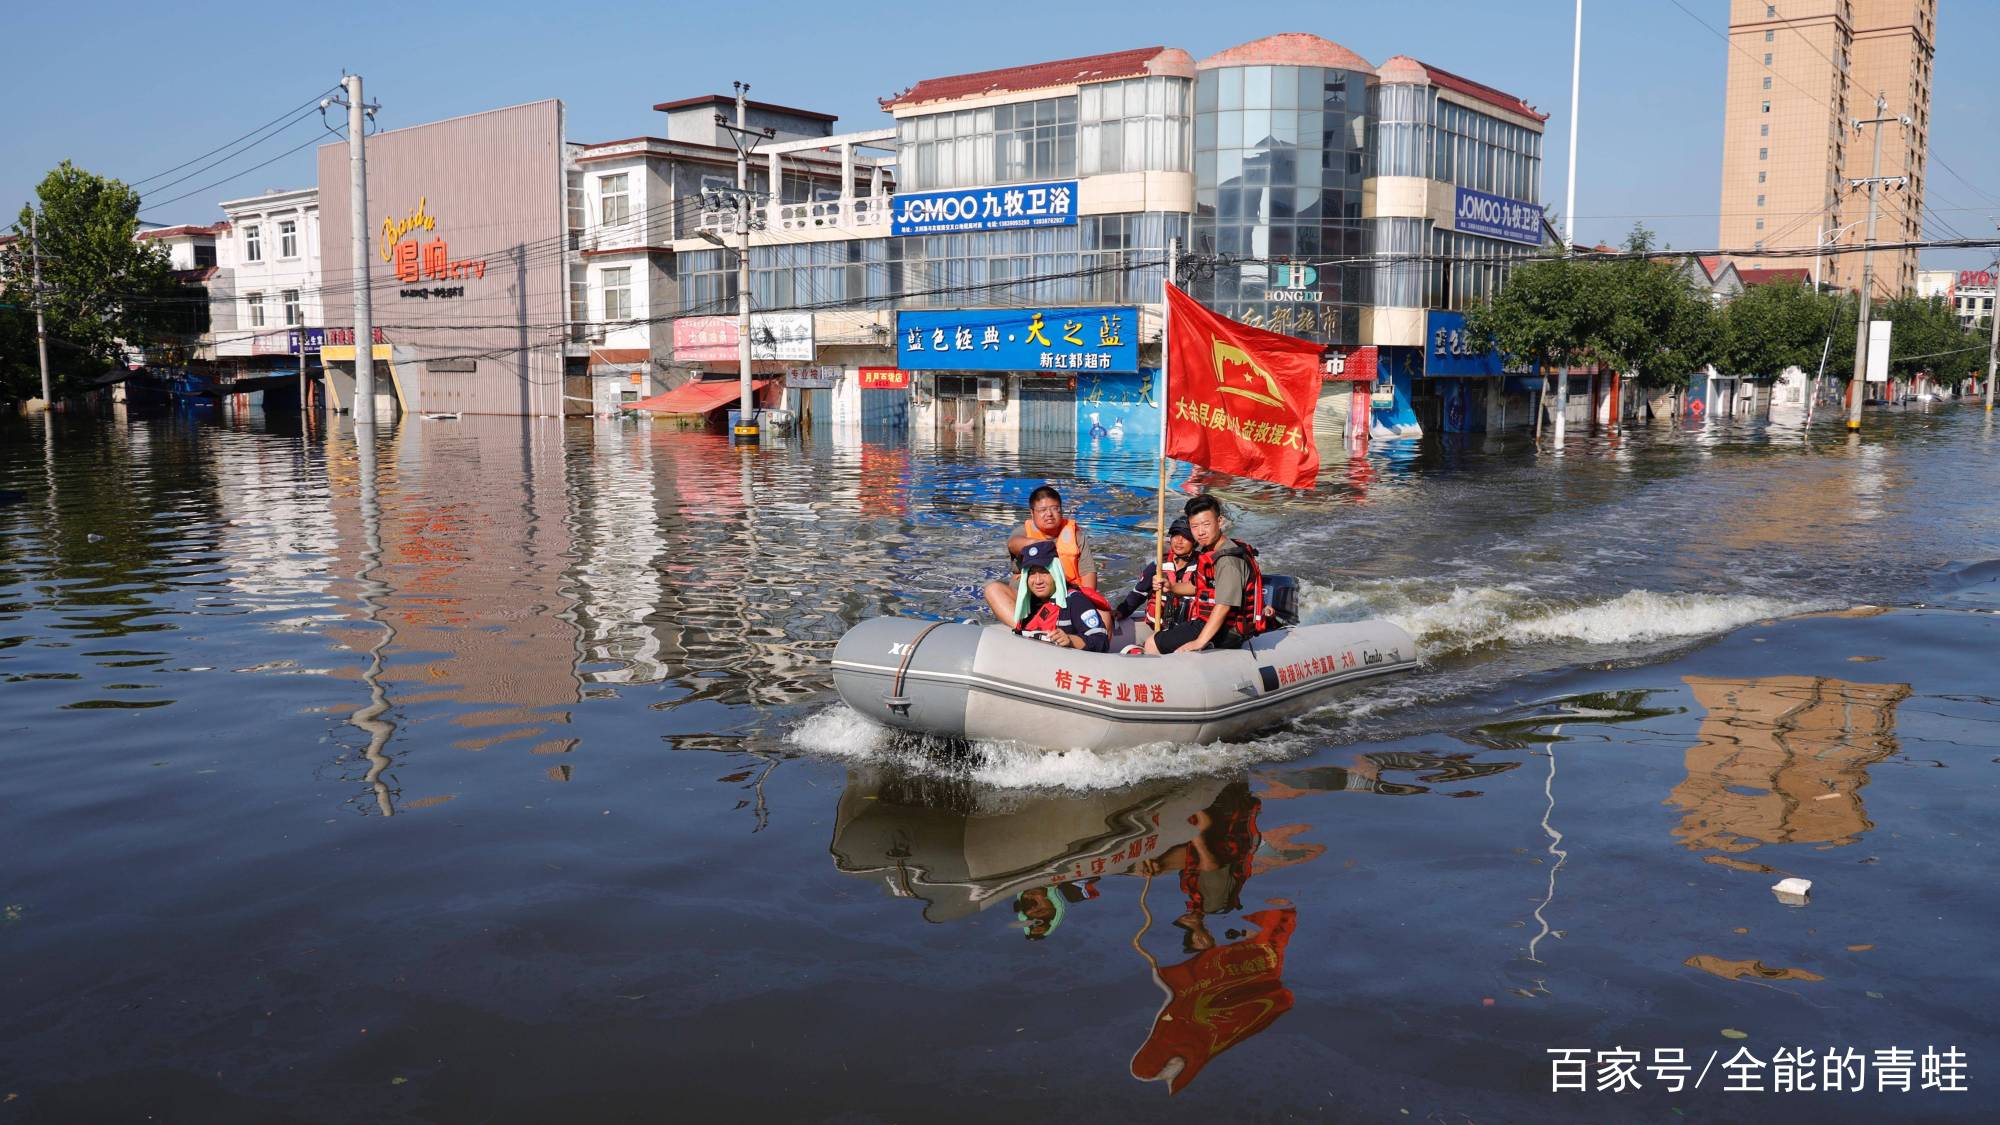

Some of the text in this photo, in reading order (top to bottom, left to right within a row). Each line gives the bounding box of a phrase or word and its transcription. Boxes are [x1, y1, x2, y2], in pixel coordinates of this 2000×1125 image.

[897, 187, 1071, 224] JOMOO 九牧卫浴
[1458, 194, 1501, 225] JOMOO
[1502, 201, 1541, 233] 九牧卫浴
[381, 196, 435, 263] Baidu
[1264, 290, 1323, 302] HONGDU
[1040, 352, 1112, 369] 新红都超市
[1325, 350, 1347, 376] 市
[1341, 650, 1357, 669] 大队
[1055, 669, 1166, 704] 桔子车业赠送
